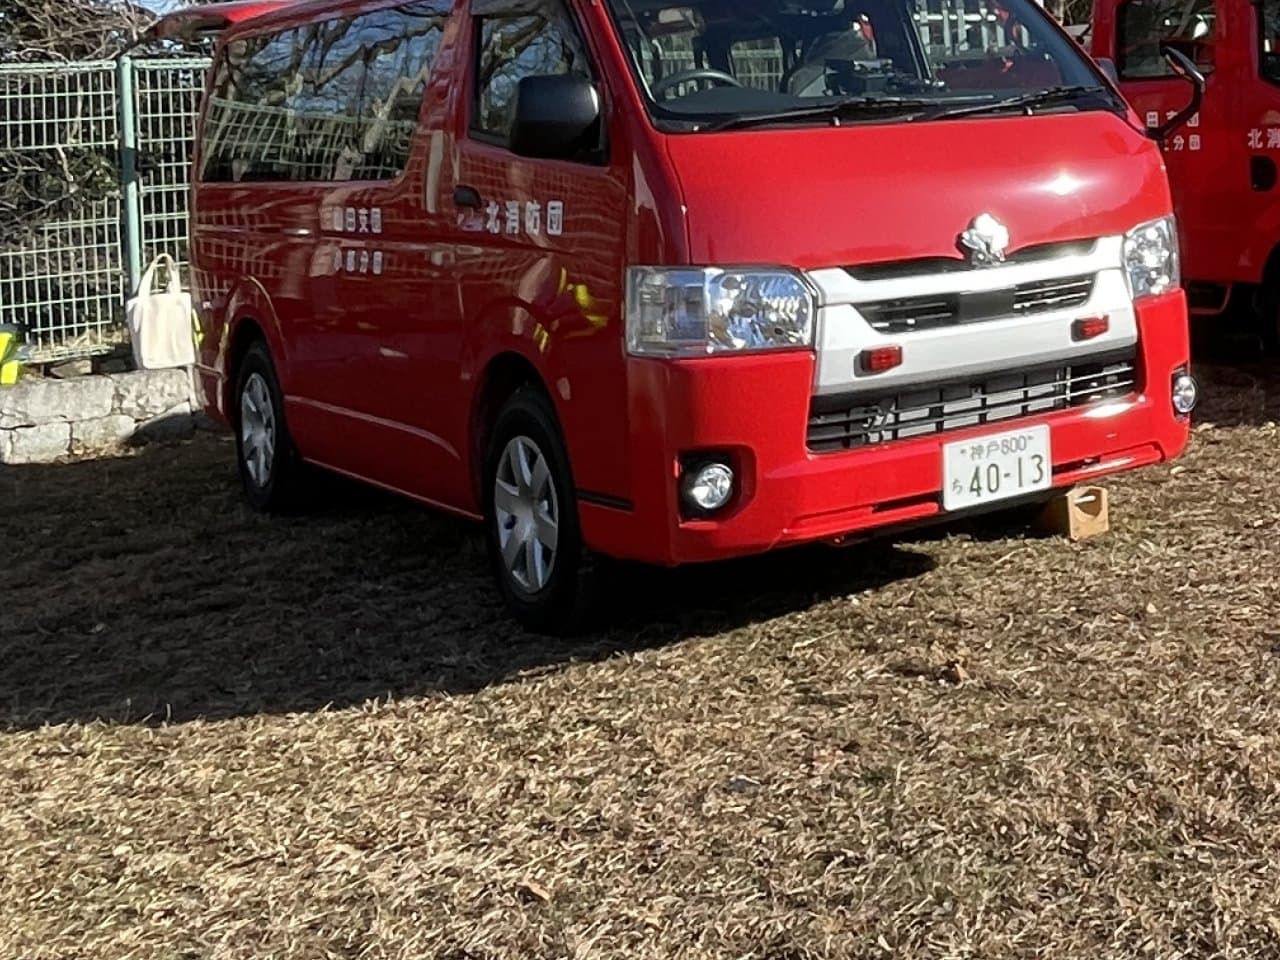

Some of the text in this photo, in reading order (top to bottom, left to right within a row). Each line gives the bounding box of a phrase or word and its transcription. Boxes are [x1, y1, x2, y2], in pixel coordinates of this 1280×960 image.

[486, 200, 563, 235] 北消防団
[968, 454, 1044, 497] 40-13
